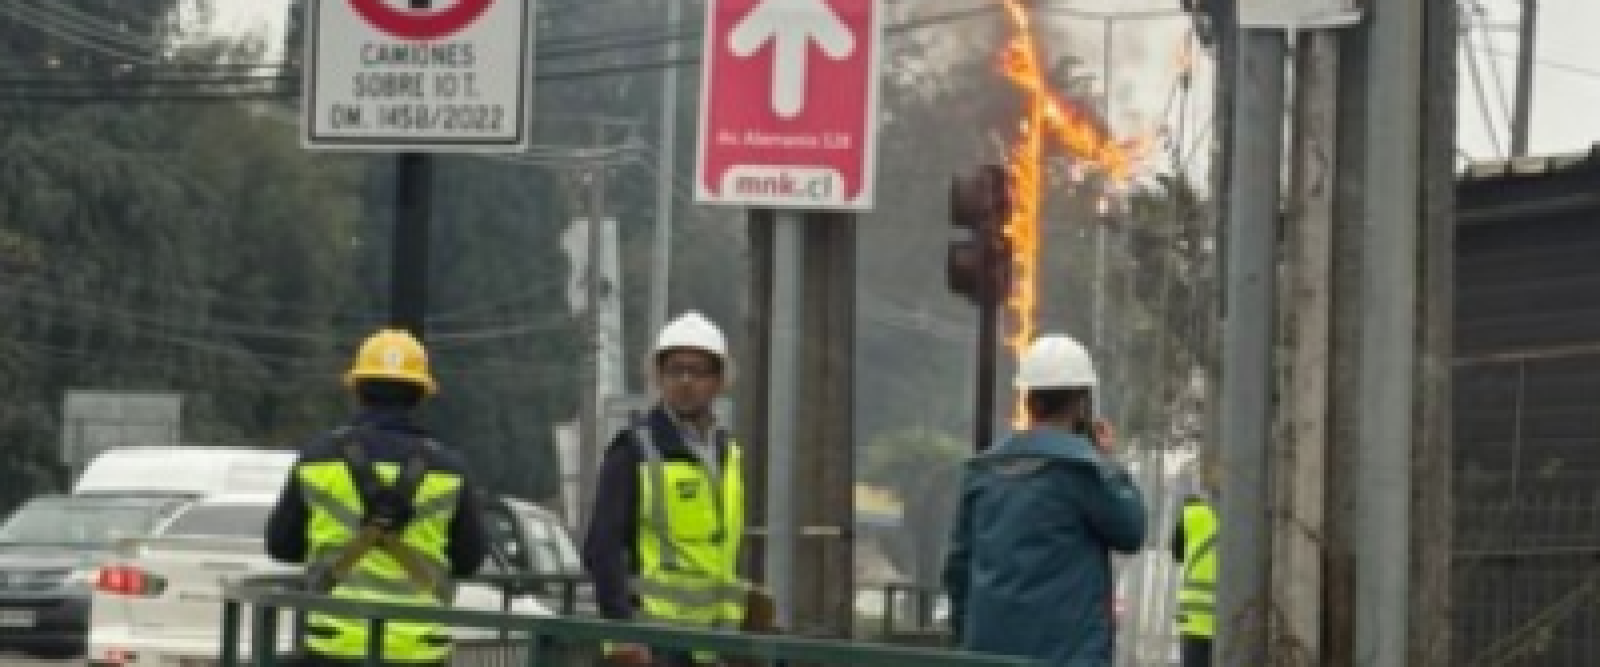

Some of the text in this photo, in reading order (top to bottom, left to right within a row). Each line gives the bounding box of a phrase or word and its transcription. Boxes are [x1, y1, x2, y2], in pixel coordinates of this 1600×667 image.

[360, 42, 475, 68] CAMIONES
[352, 72, 424, 98] SOBRE
[435, 72, 459, 98] 10
[736, 172, 833, 199] mnk.cl
